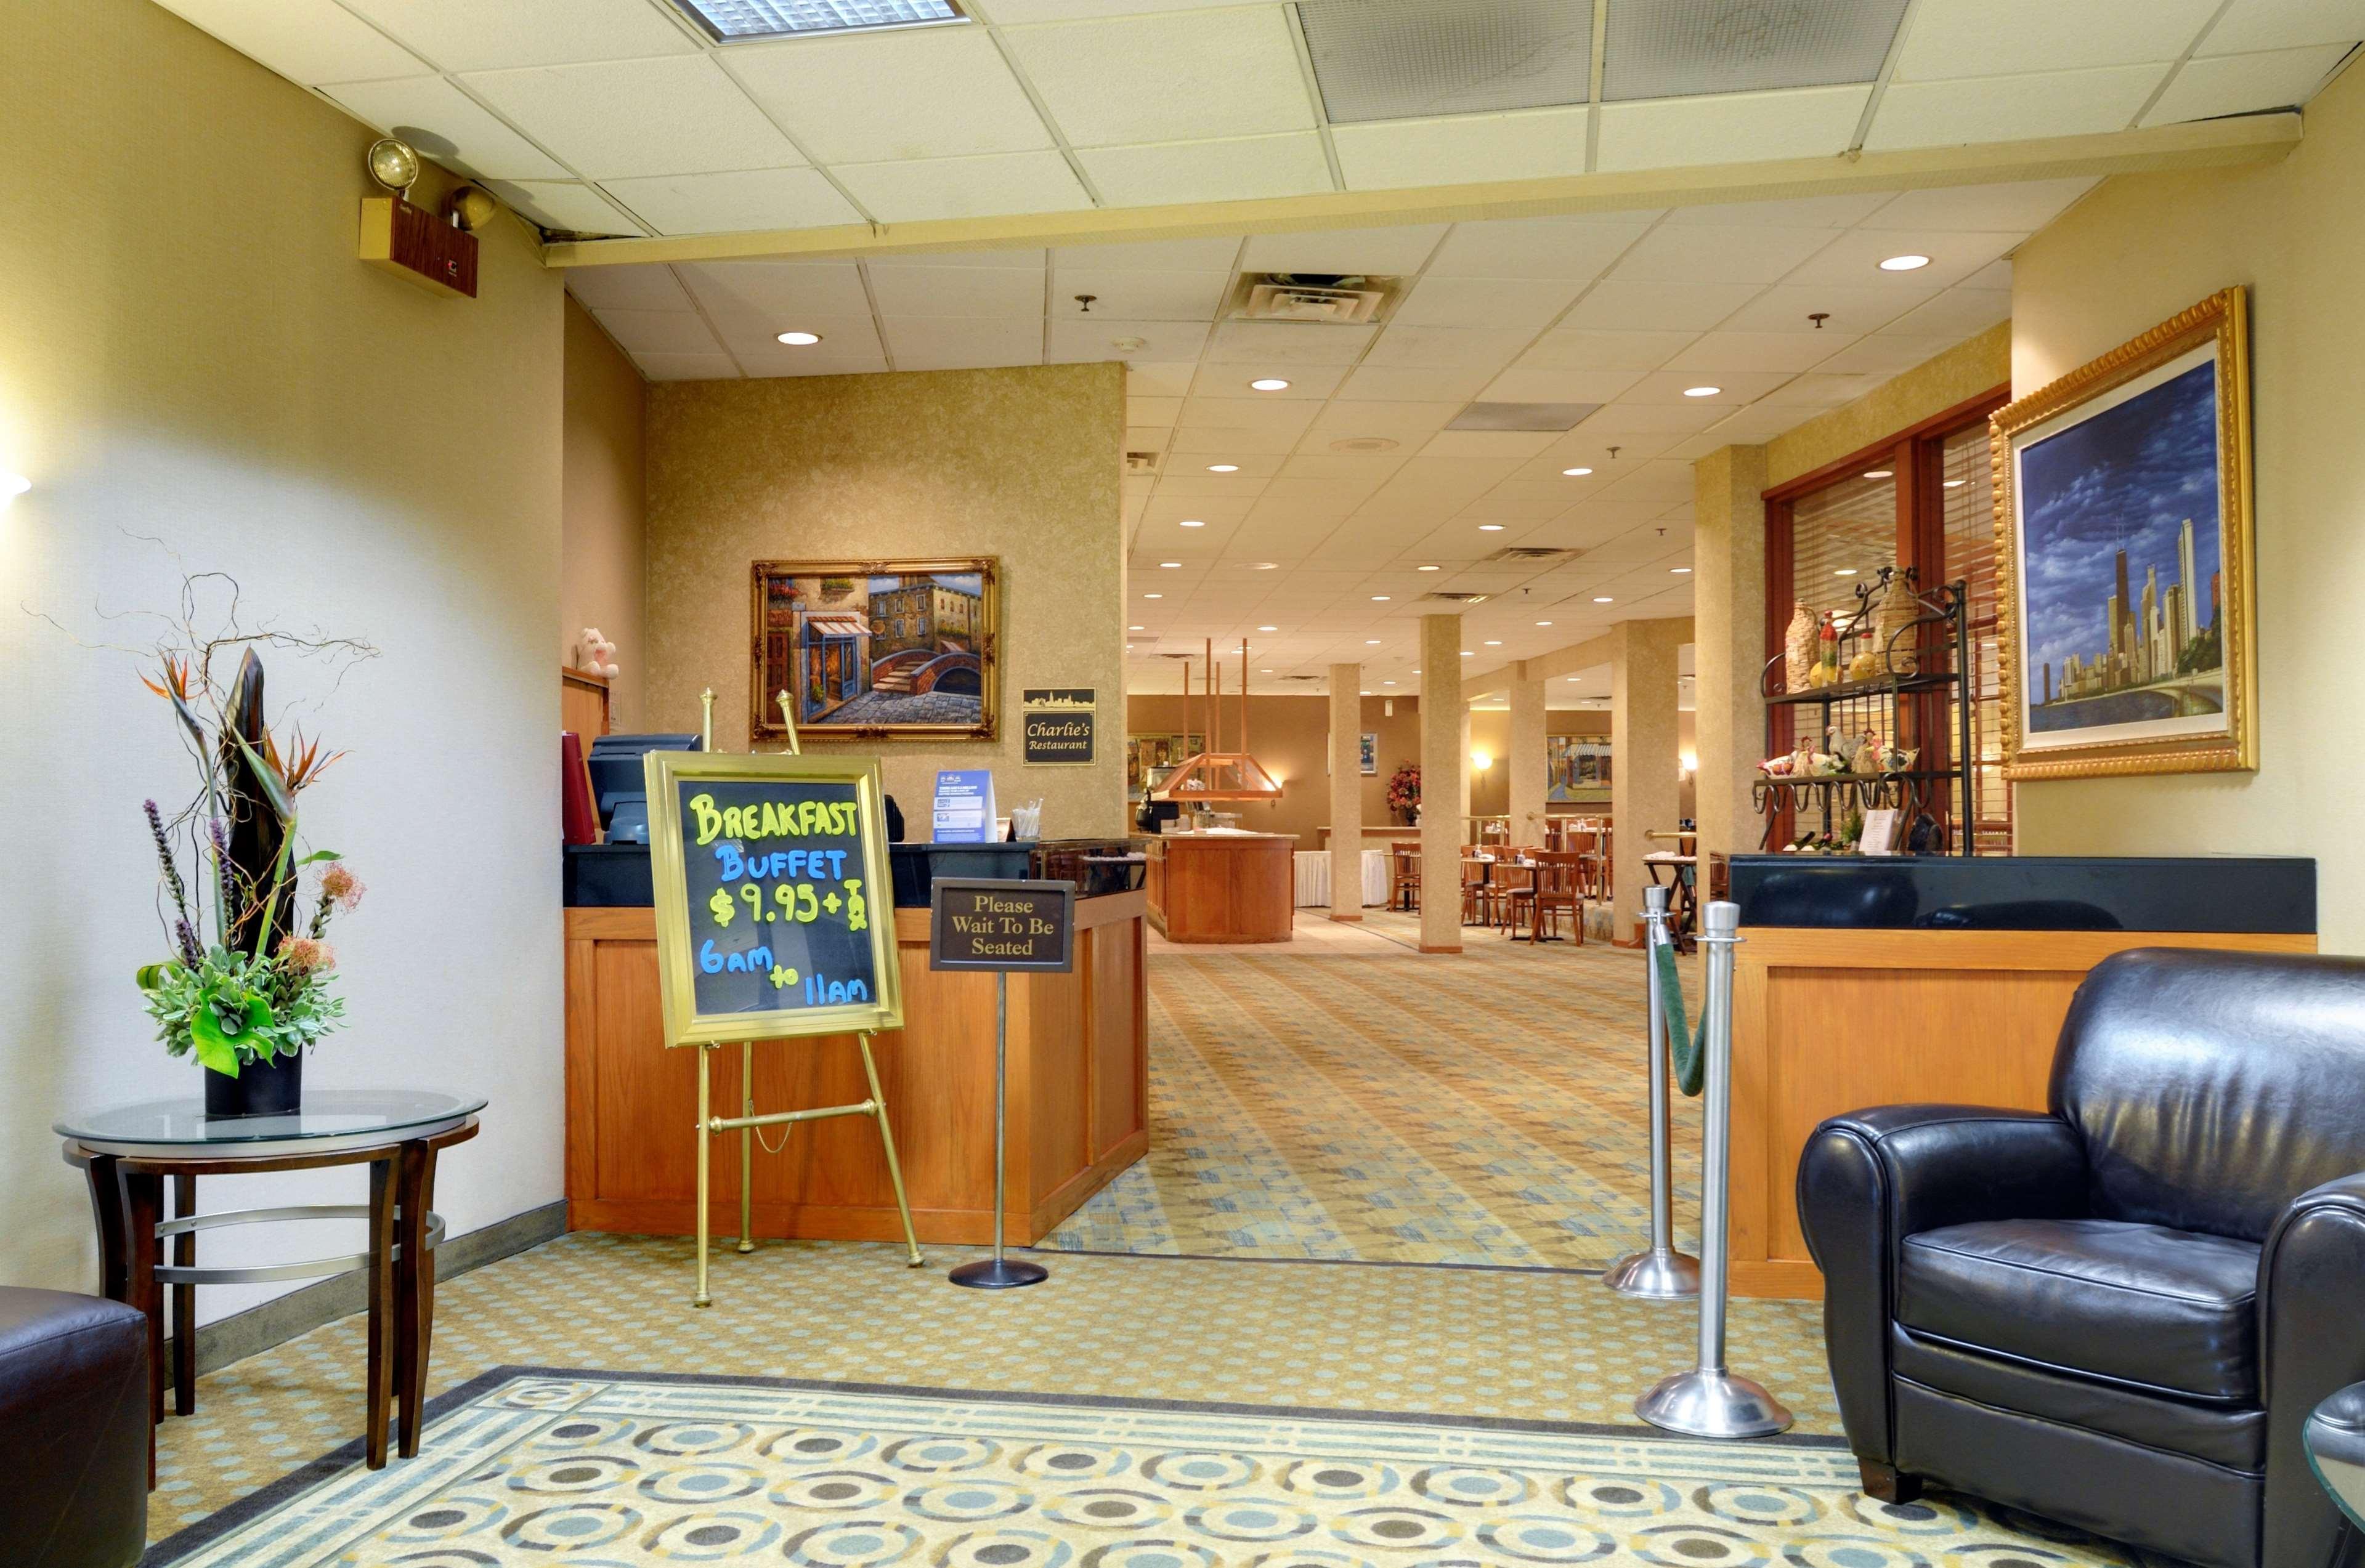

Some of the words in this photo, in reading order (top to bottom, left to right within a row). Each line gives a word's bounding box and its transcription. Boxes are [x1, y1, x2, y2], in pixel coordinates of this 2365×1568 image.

[1027, 722, 1090, 737] Charlie's
[1029, 740, 1087, 750] Restaurant
[690, 793, 858, 845] BREAKFAST
[715, 845, 847, 881] BUFFET
[974, 895, 1034, 913] Please
[952, 916, 994, 934] Wait
[999, 917, 1023, 934] To
[1029, 918, 1054, 935] Be
[972, 937, 1033, 955] Seated
[769, 964, 799, 989] to
